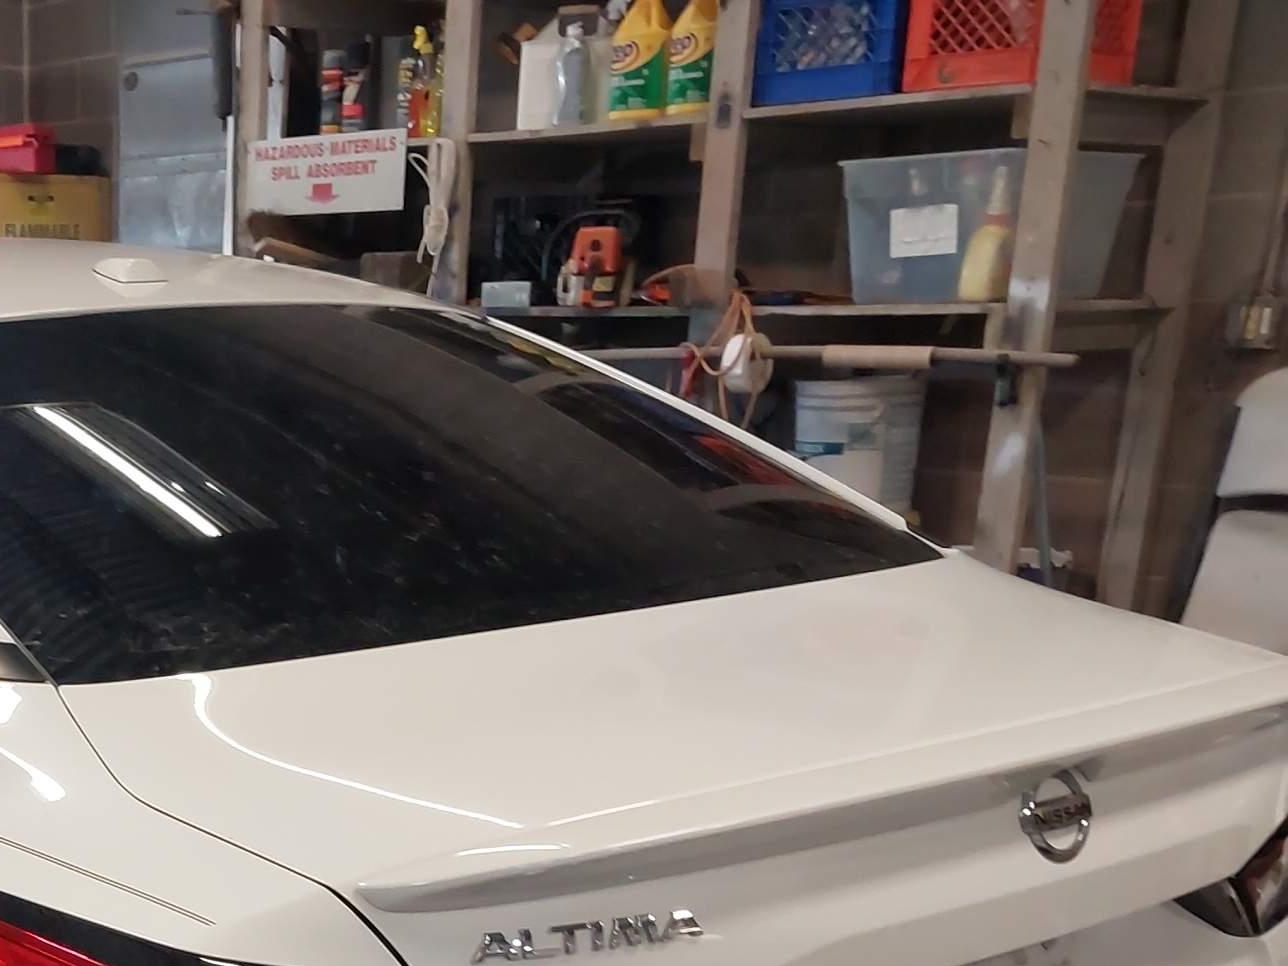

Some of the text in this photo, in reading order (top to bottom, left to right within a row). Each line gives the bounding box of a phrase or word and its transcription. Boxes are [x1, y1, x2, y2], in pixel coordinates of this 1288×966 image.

[255, 136, 397, 161] HAZARDOUS MATERIALS
[271, 160, 378, 181] SPILL ABSORBENT
[471, 909, 705, 965] ALTIMA
